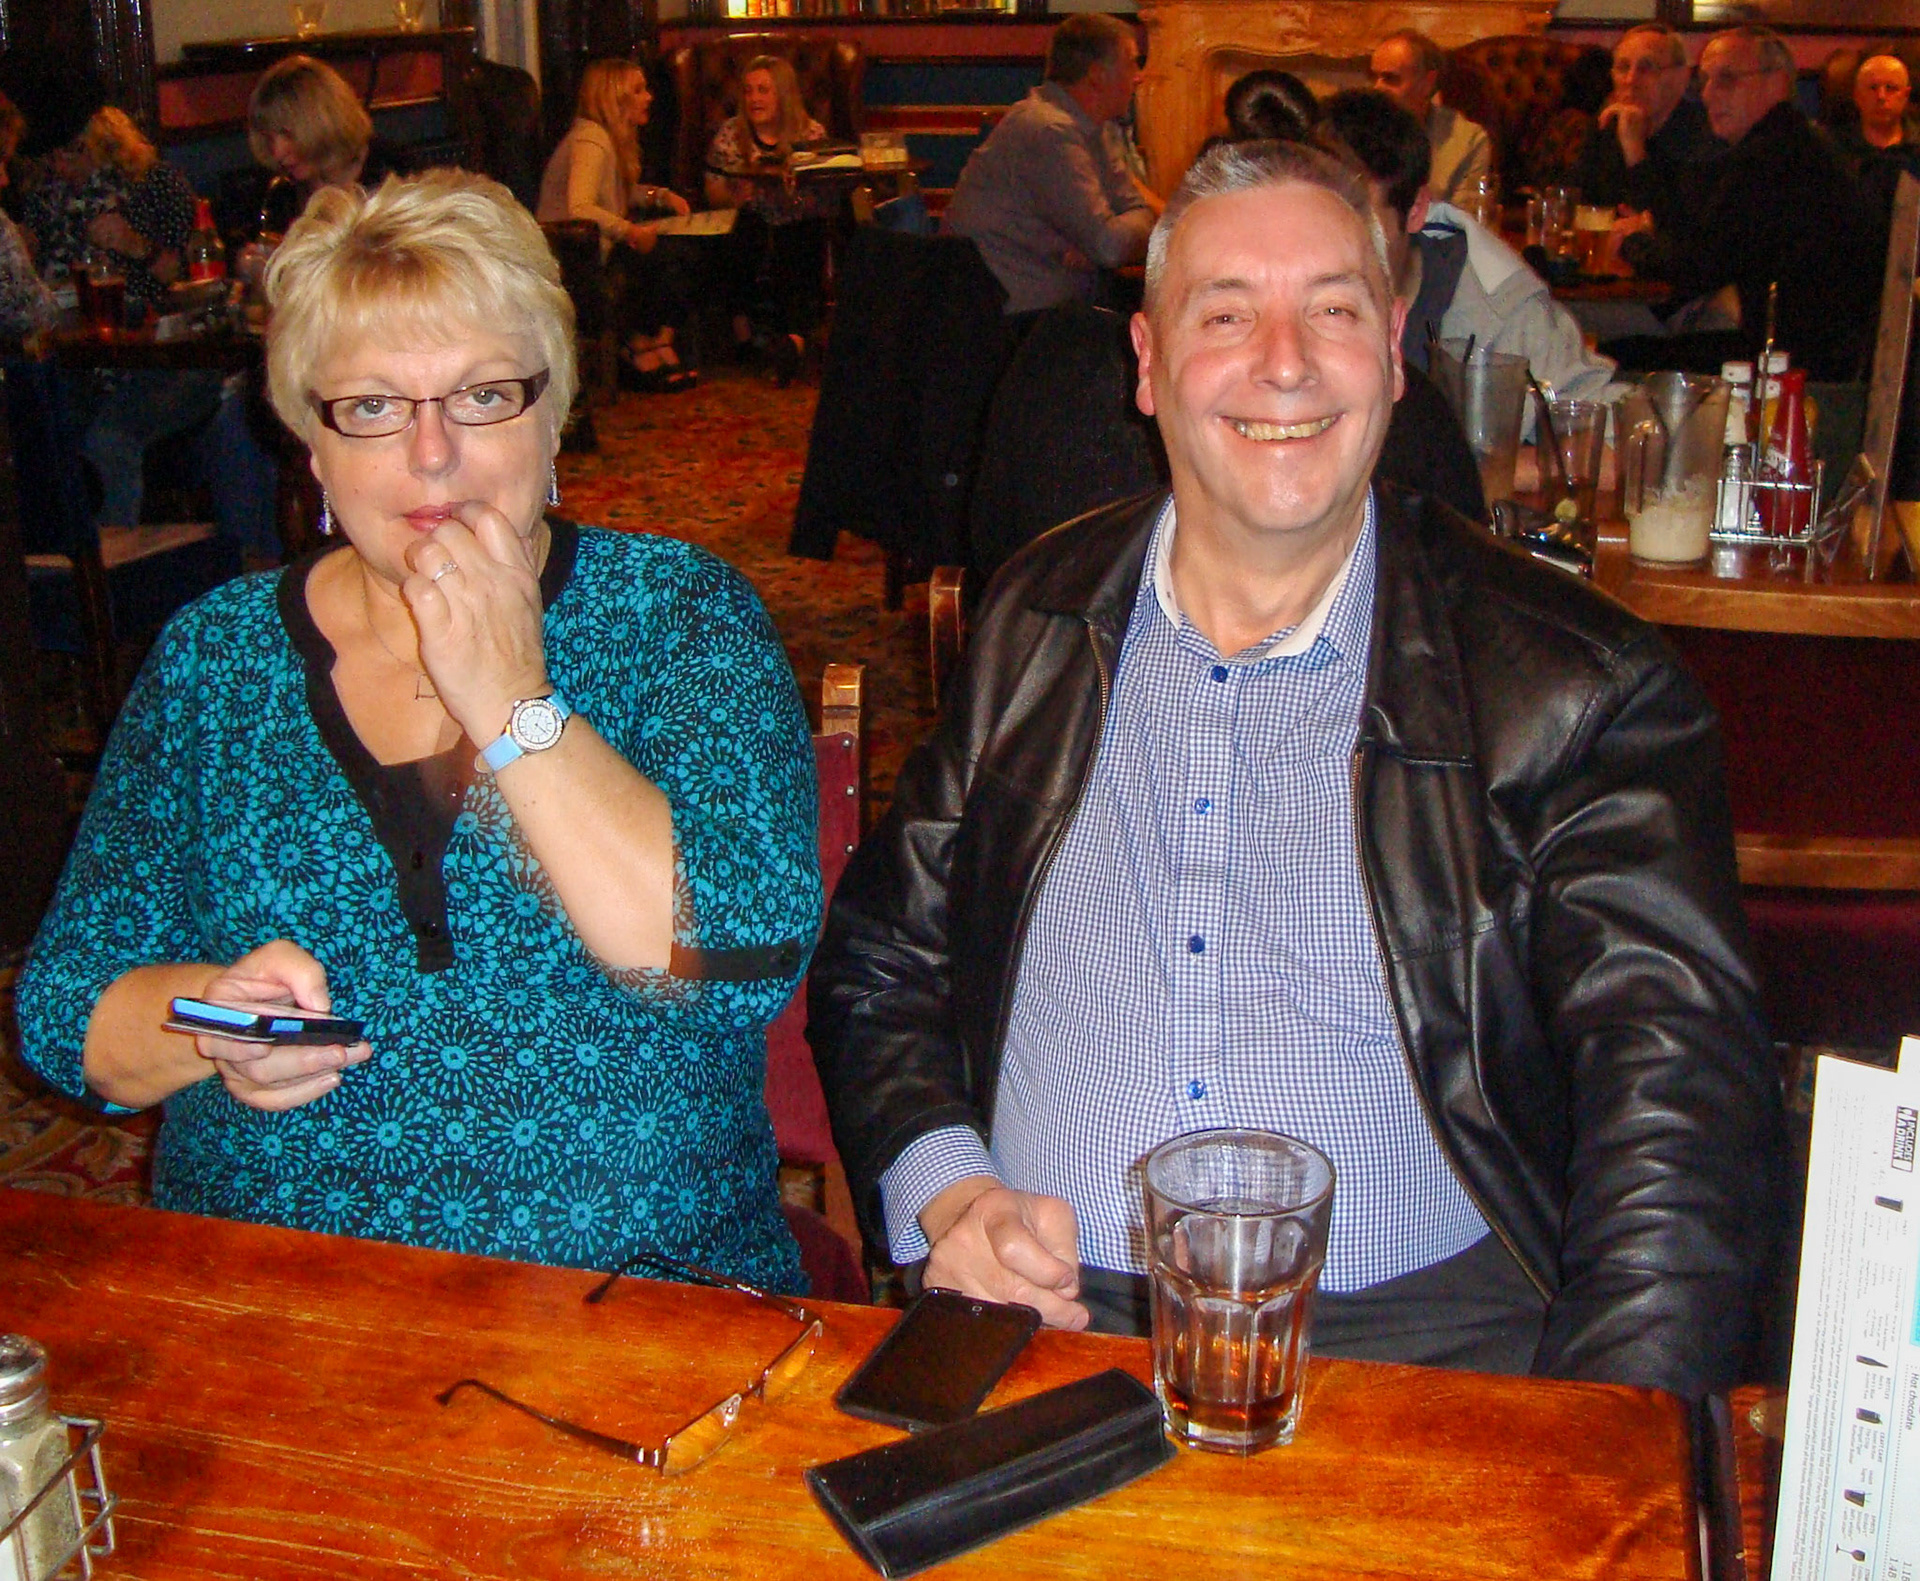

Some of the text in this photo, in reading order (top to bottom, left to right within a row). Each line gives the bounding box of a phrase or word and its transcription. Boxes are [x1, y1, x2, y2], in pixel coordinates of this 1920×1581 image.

[1893, 1118, 1906, 1158] A DRINK
[1904, 1121, 1915, 1160] INCLUDES
[1905, 1372, 1919, 1430] Hot chocolate
